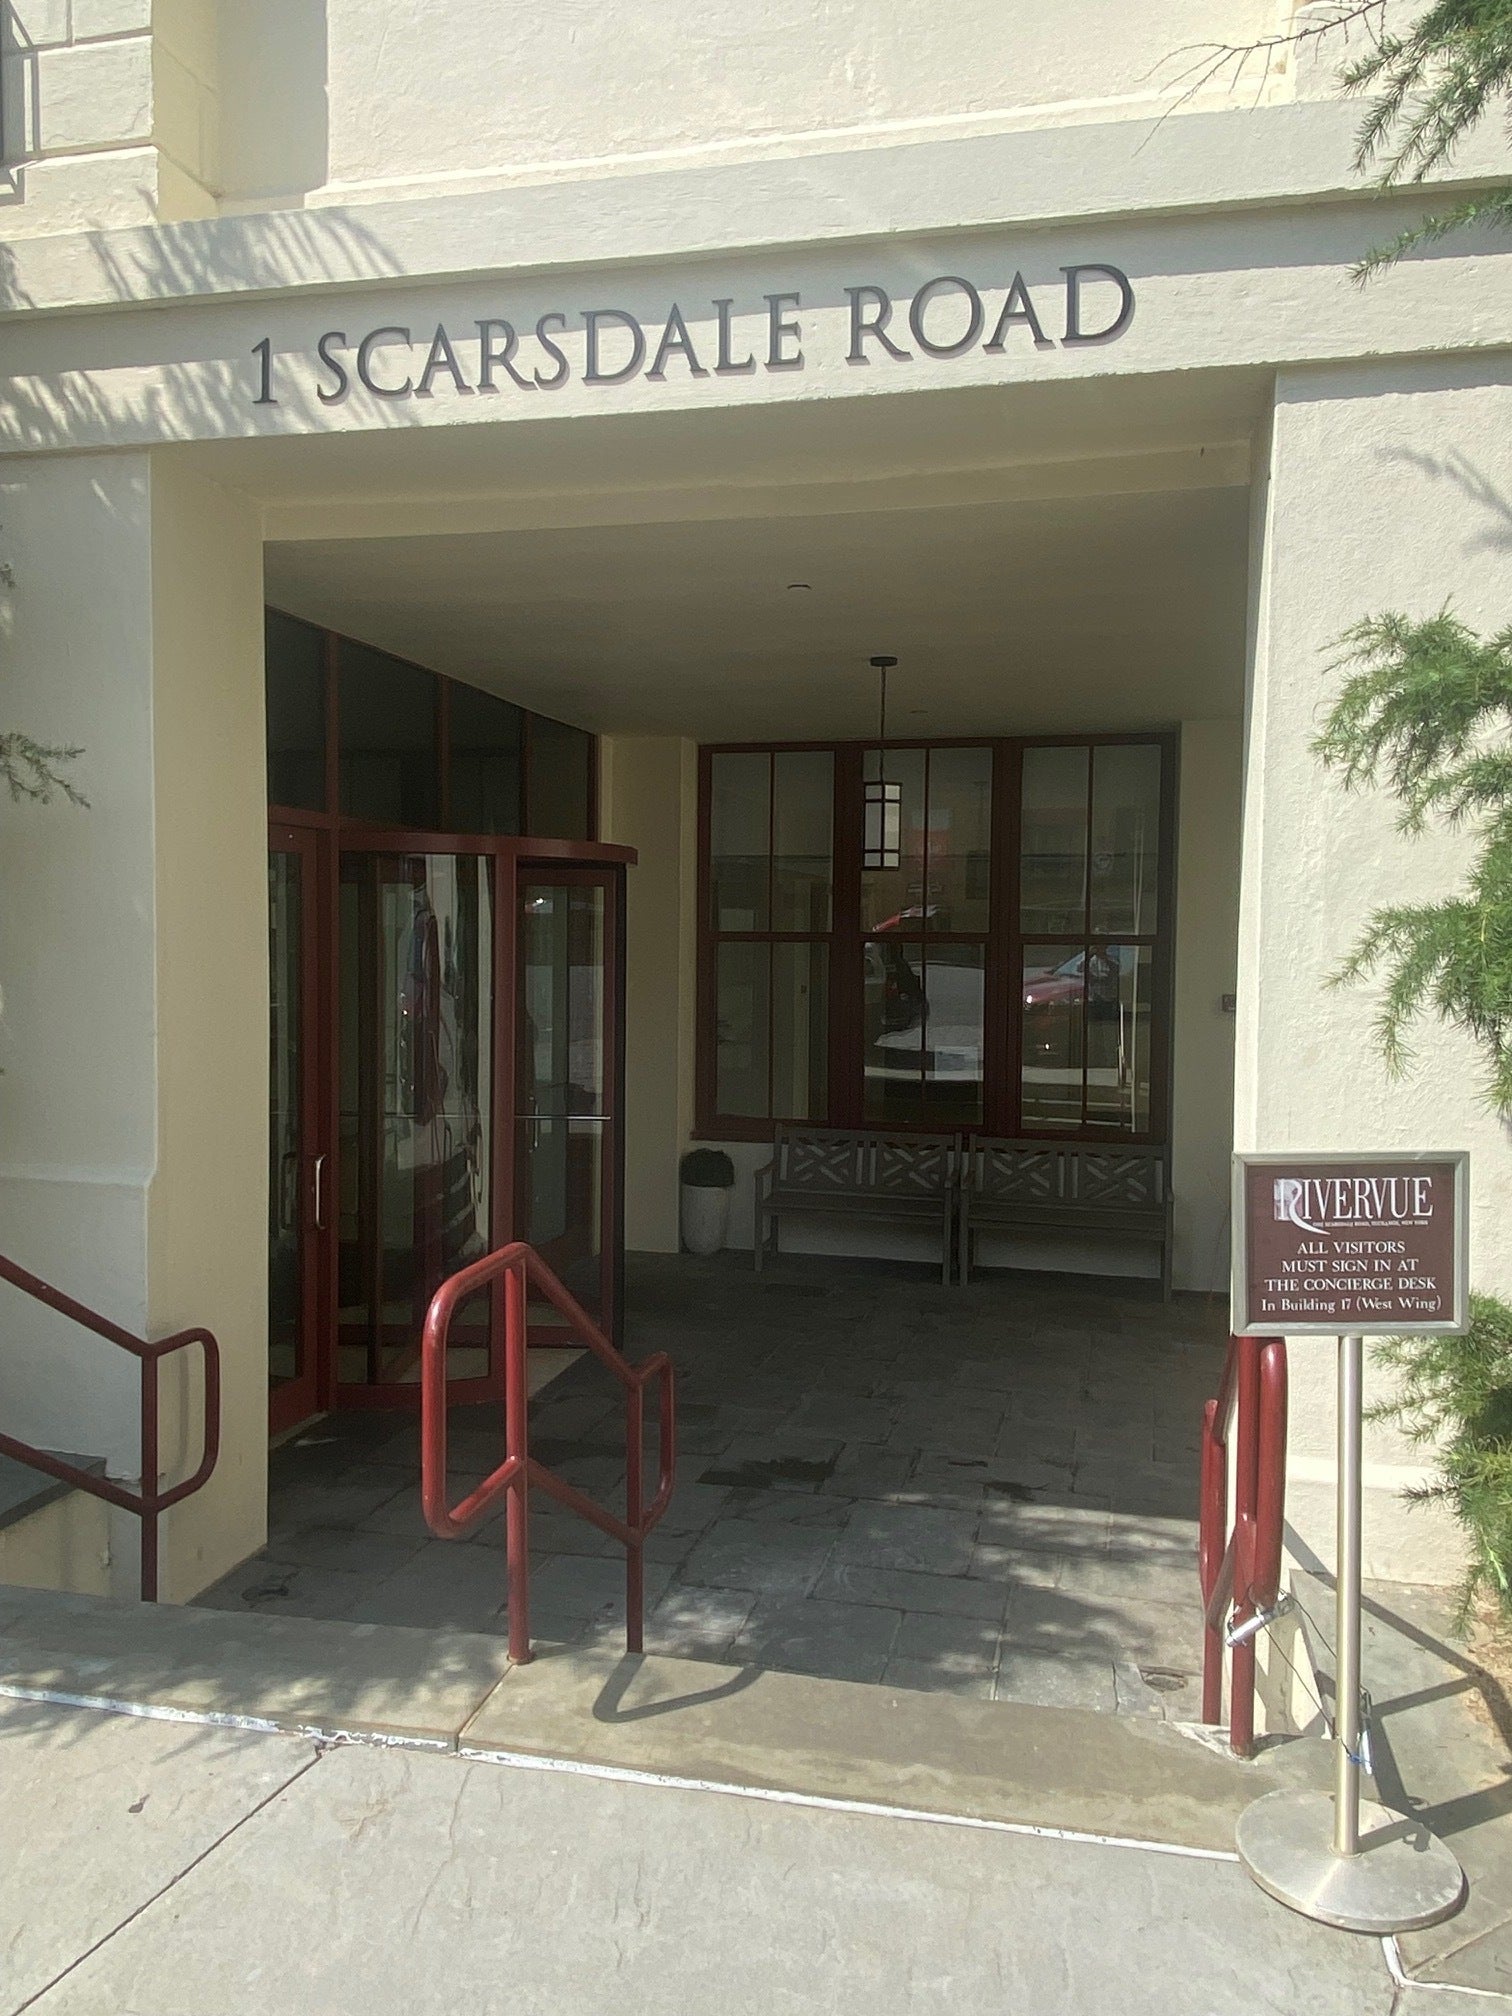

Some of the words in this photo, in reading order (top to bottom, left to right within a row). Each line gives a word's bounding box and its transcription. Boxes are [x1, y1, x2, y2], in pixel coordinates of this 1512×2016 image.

[251, 336, 279, 405] 1
[316, 291, 806, 406] SCARSDALE
[842, 262, 1137, 365] ROAD
[1276, 1176, 1434, 1235] RIVERVUE
[1297, 1241, 1328, 1254] ALL
[1333, 1240, 1405, 1254] VISITORS
[1281, 1259, 1327, 1273] MUST
[1332, 1259, 1368, 1272] SIGN
[1374, 1258, 1391, 1271] IN
[1397, 1258, 1419, 1271] AT
[1264, 1278, 1299, 1292] THE
[1303, 1277, 1393, 1291] CONCIERGE
[1398, 1276, 1436, 1290] DESK
[1261, 1298, 1276, 1311] In
[1281, 1298, 1336, 1314] Building
[1341, 1298, 1351, 1311] 17
[1356, 1297, 1393, 1311] (West
[1399, 1295, 1442, 1313] Wing)
